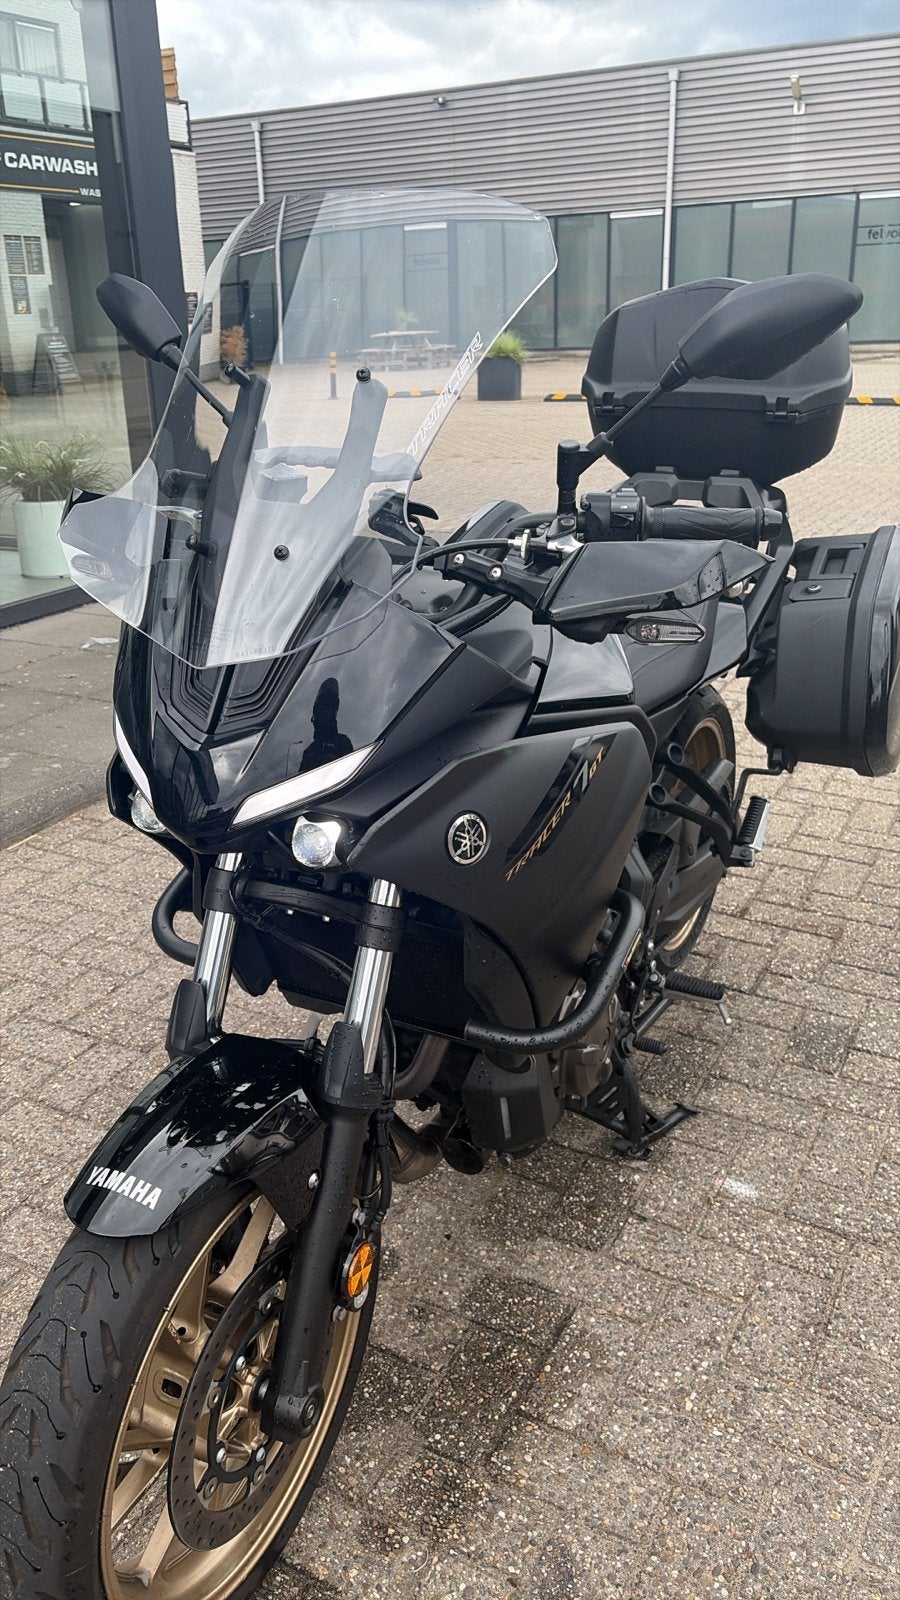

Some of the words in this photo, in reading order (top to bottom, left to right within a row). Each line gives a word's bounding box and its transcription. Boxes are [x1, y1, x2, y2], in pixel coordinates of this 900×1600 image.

[3, 151, 99, 177] CARWASH
[406, 331, 484, 456] TRACER
[504, 789, 571, 882] TRACER
[572, 759, 589, 793] 7
[85, 1166, 163, 1211] YAMAHA
